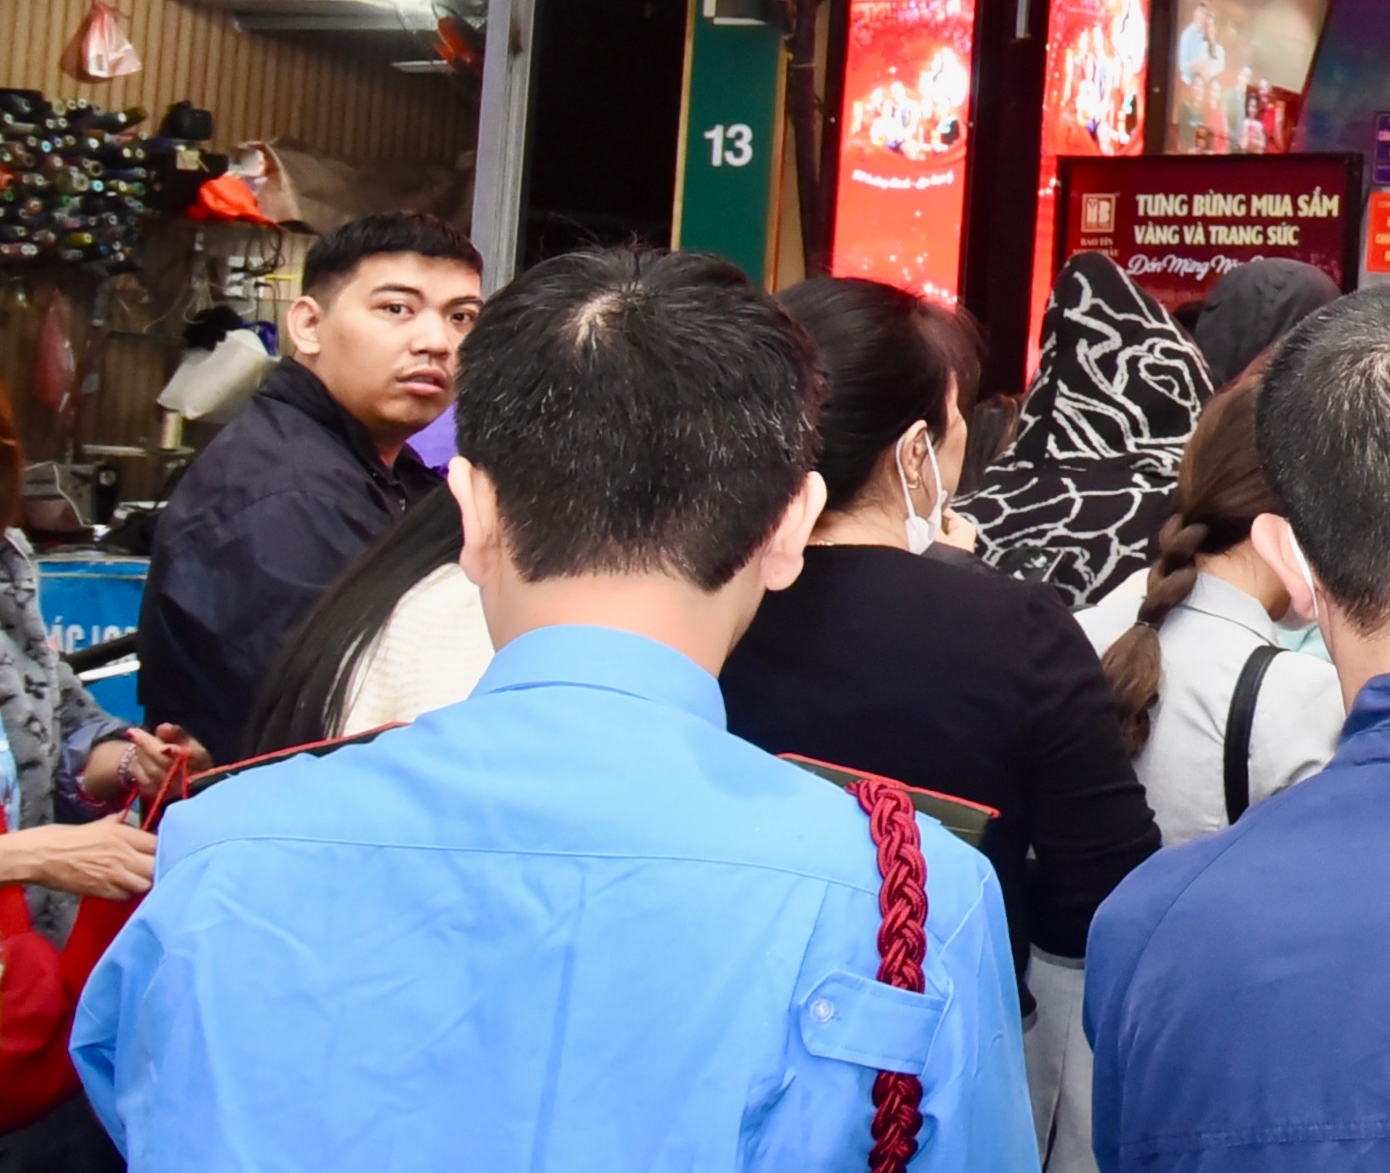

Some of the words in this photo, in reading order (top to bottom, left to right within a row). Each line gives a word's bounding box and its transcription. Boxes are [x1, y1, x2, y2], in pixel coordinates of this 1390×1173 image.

[703, 123, 754, 168] 13
[1250, 193, 1294, 218] MUA
[1297, 186, 1341, 218] SẮM
[1134, 221, 1180, 246] VÀNG
[1183, 221, 1206, 246] VÀ
[1209, 225, 1265, 246] TRANG
